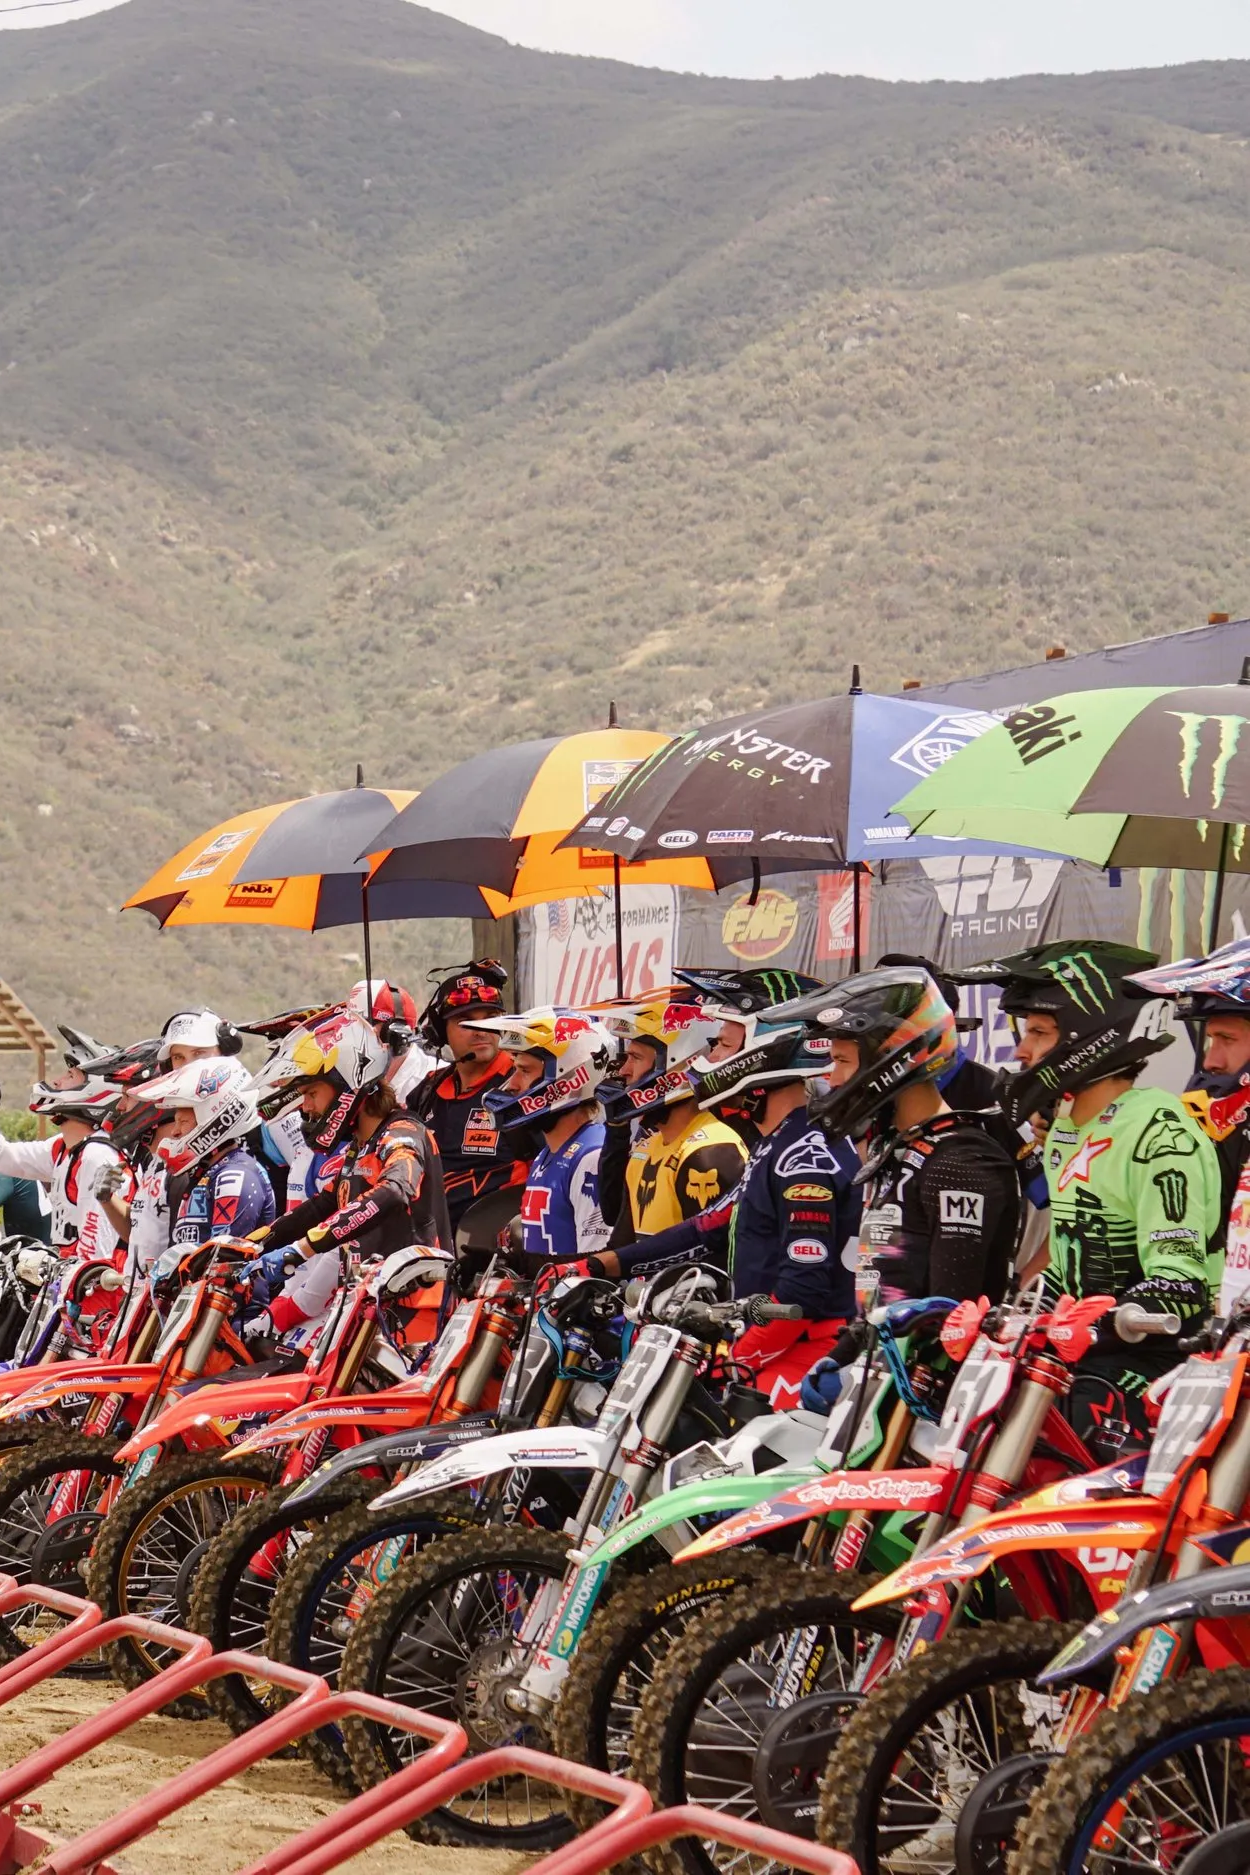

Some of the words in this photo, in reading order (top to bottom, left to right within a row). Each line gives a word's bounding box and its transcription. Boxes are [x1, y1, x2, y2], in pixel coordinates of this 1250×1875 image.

[664, 835, 691, 844] BELL
[709, 831, 753, 839] PARTS
[605, 905, 670, 929] PEFORMANCE
[722, 899, 799, 945] FMF
[951, 911, 1039, 938] RACING
[809, 1038, 831, 1049] BELL
[1057, 1027, 1121, 1073] MONSTER
[716, 1050, 768, 1079] MONSTER
[468, 1132, 492, 1143] KTM
[946, 1195, 979, 1220] MX
[794, 1211, 831, 1223] YAMAHA
[793, 1246, 823, 1257] BELL
[459, 1421, 486, 1429] TOMAC
[455, 1430, 483, 1440] YAMAHA
[564, 1562, 603, 1630] MOTOREX
[653, 1578, 735, 1615] DUNLOP
